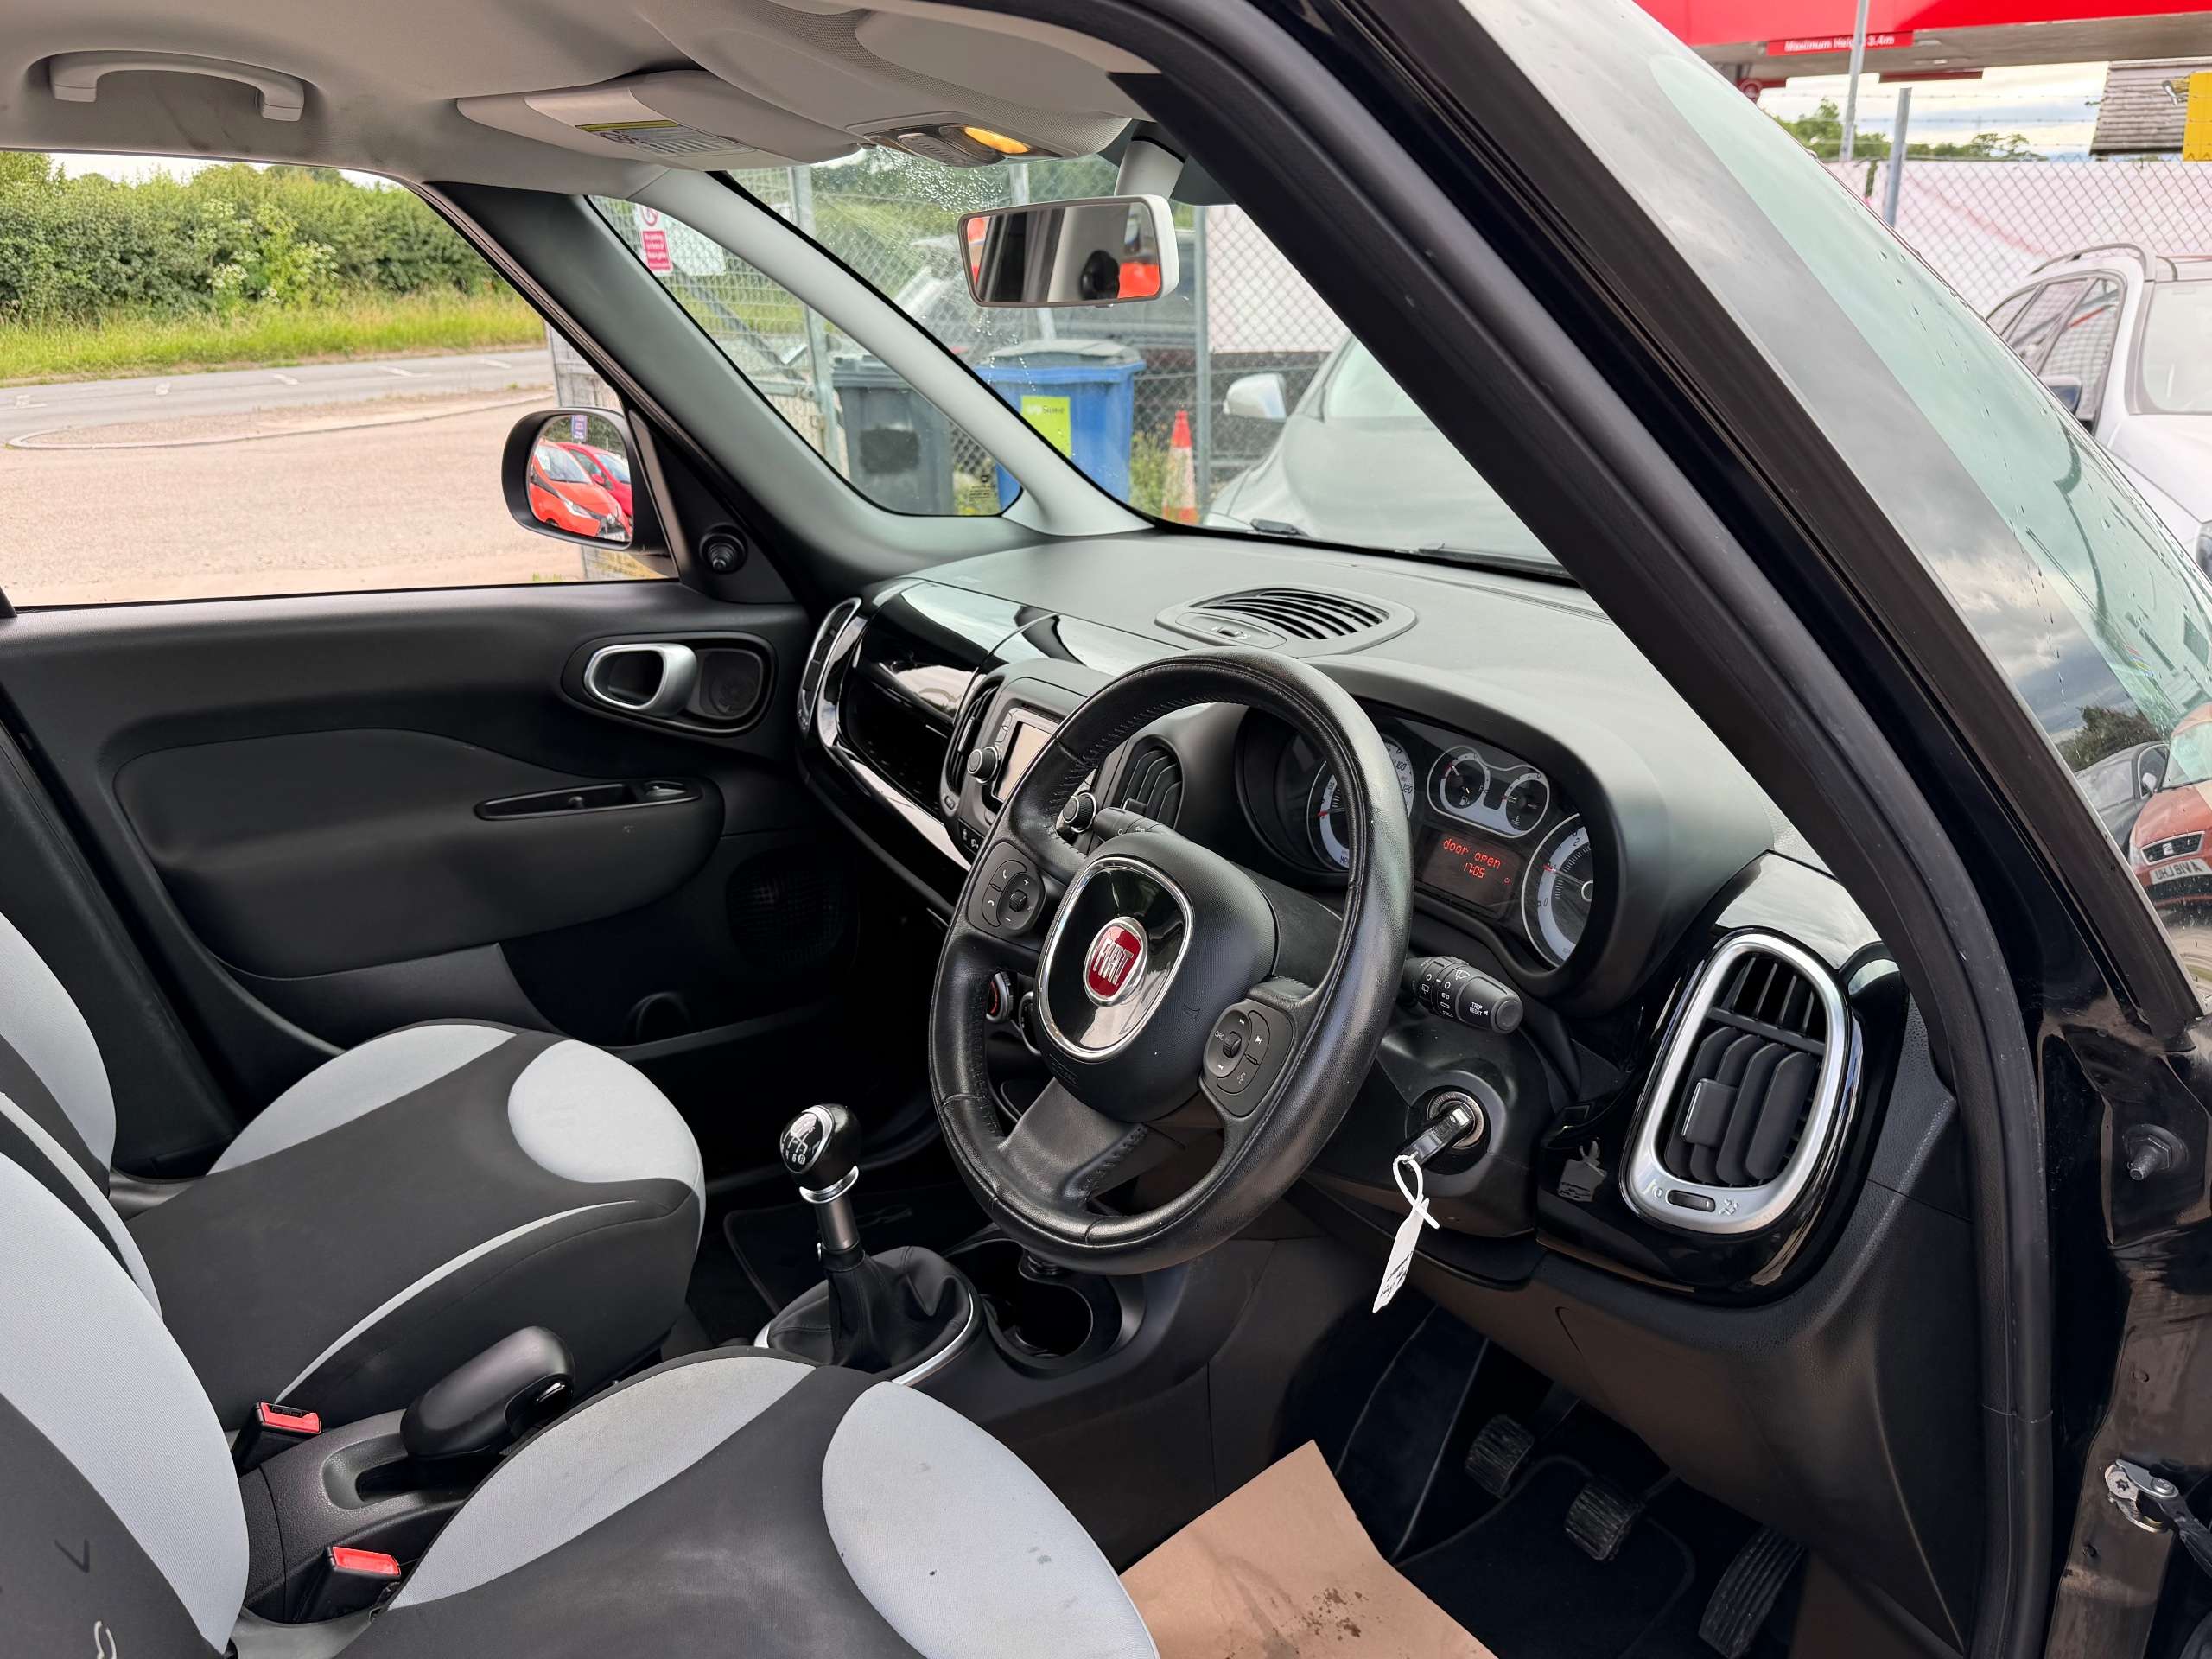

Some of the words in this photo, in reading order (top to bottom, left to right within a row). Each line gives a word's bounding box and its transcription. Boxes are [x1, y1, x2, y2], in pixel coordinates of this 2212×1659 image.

[1784, 40, 1833, 52] Maximum
[1867, 35, 1895, 47] 3.4m
[1444, 838, 1469, 855] door
[1475, 852, 1501, 869] open
[1464, 863, 1485, 878] 17:05
[1093, 938, 1135, 985] FIAT
[1469, 1007, 1483, 1016] RESET
